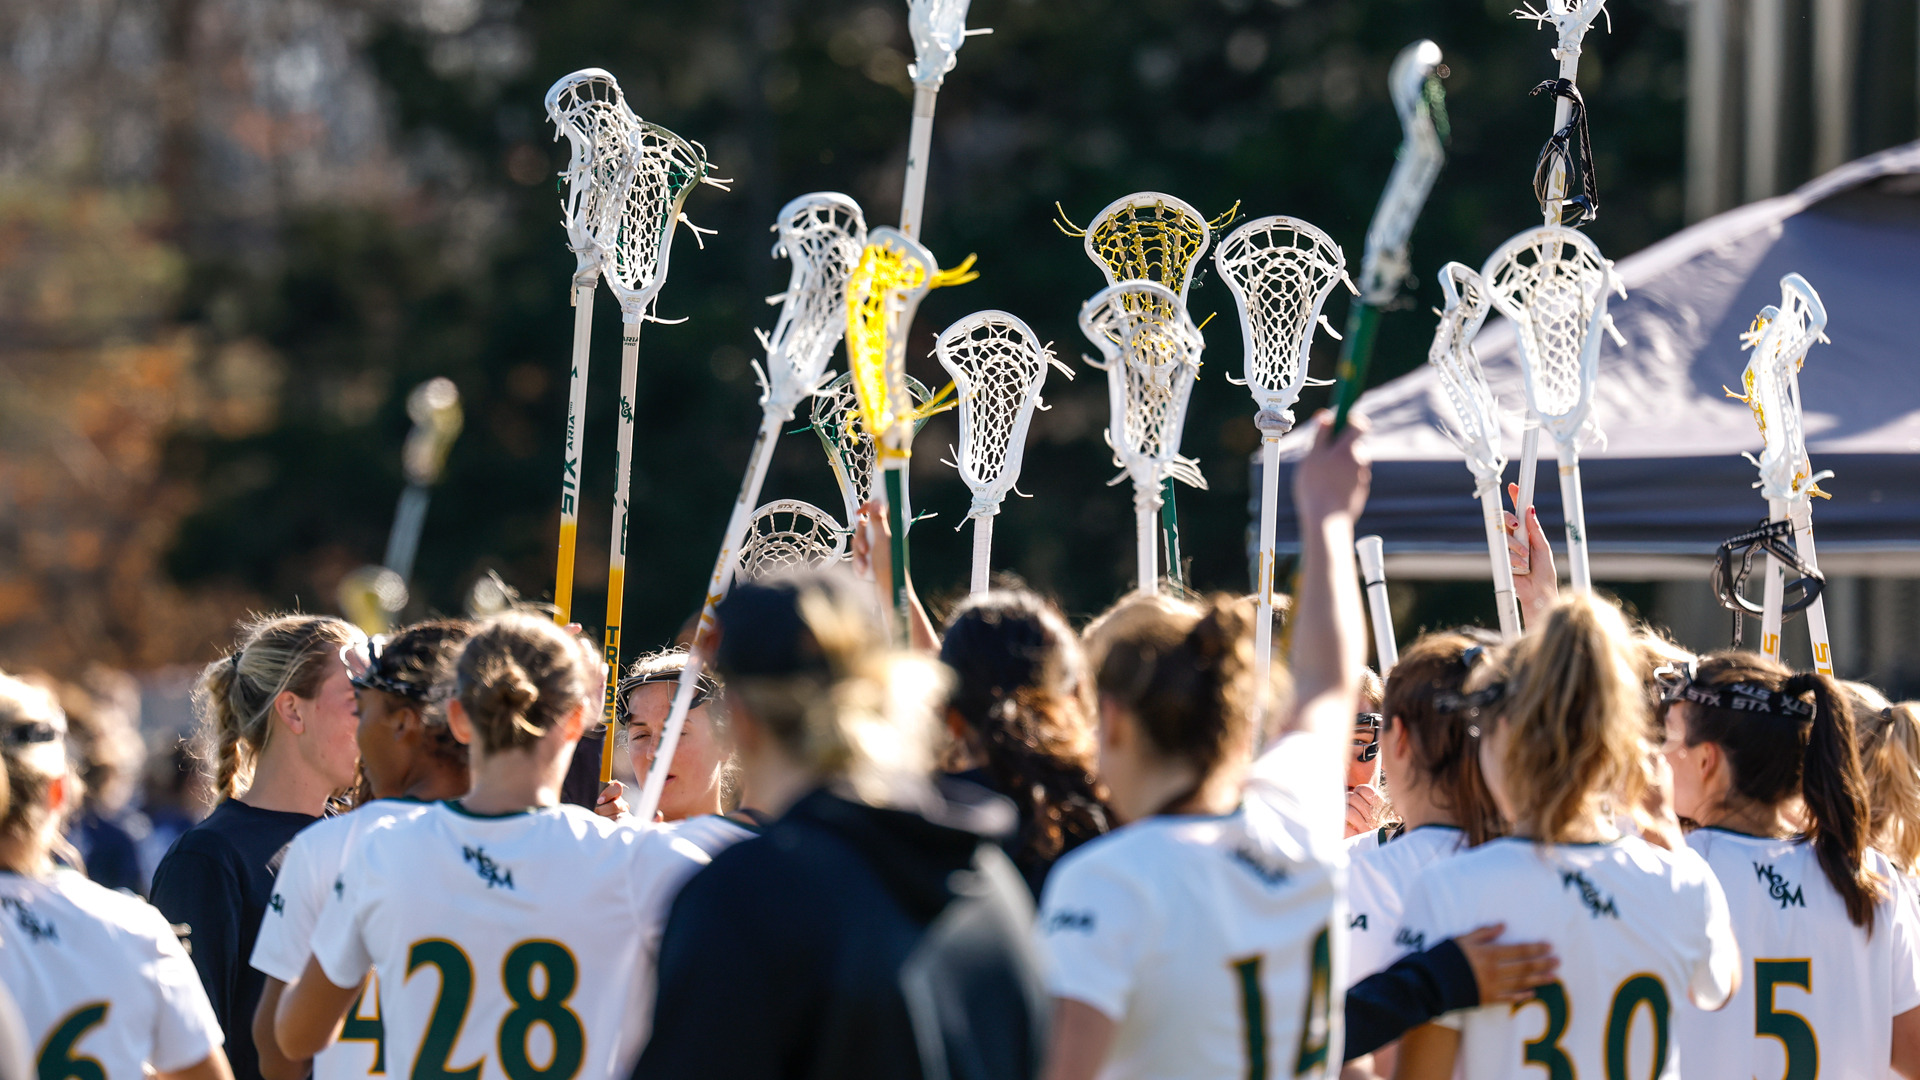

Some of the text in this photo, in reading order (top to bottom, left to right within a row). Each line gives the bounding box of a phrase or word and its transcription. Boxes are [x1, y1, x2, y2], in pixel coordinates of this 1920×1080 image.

[566, 414, 576, 451] ARIA
[561, 457, 578, 517] STX
[602, 625, 620, 724] TRIBE
[1686, 687, 1721, 707] STX
[1731, 696, 1772, 713] STX
[1753, 861, 1806, 909] W&M
[35, 1000, 113, 1080] 6
[404, 936, 588, 1080] 28
[1510, 971, 1671, 1080] 30
[1753, 957, 1820, 1080] 5
